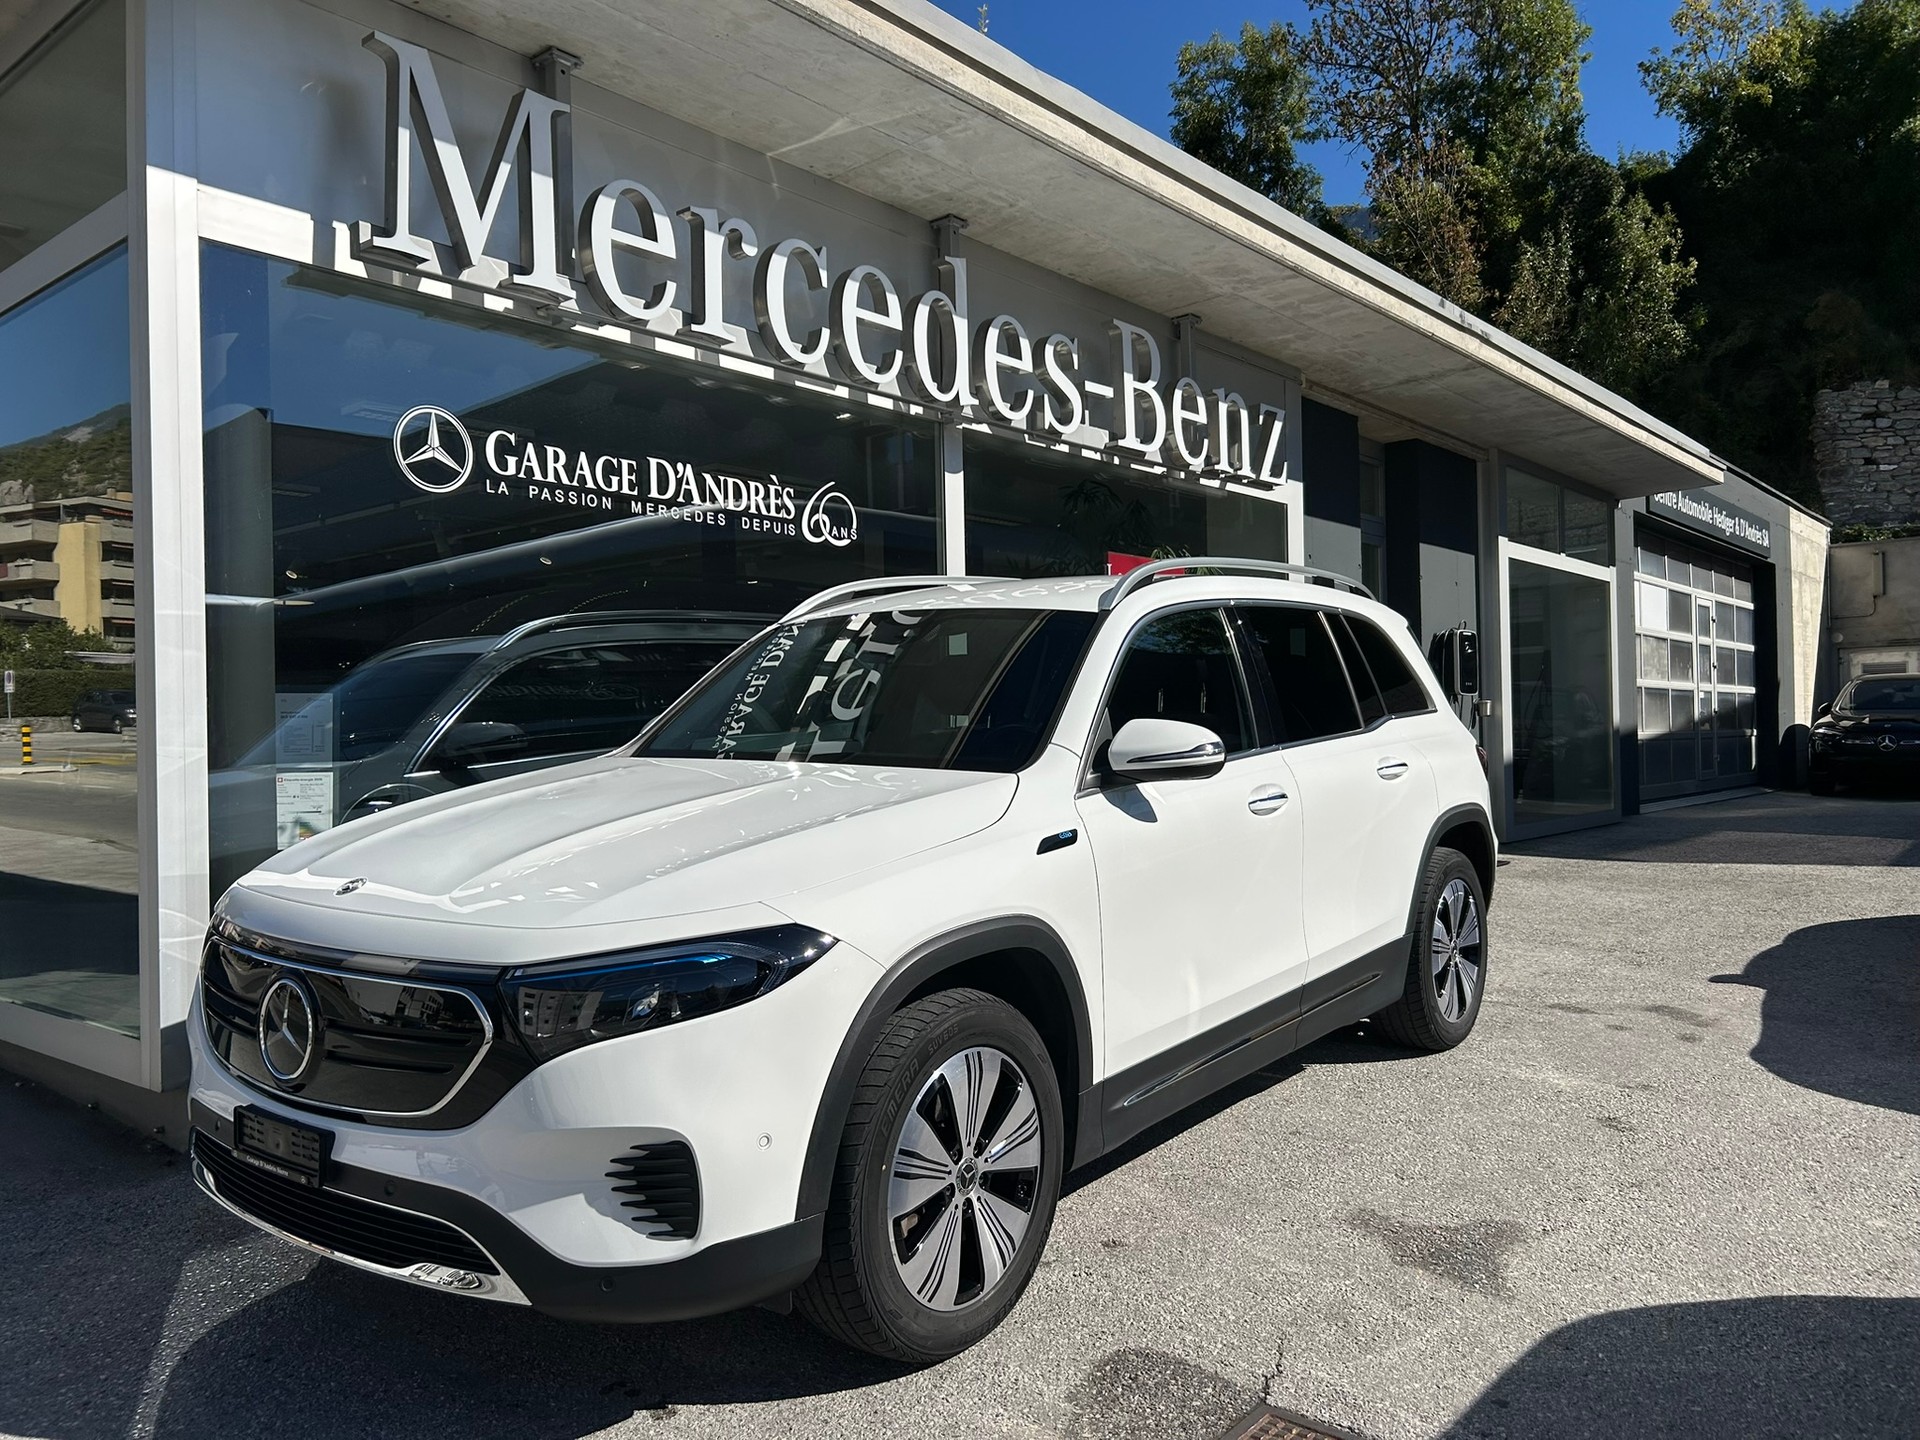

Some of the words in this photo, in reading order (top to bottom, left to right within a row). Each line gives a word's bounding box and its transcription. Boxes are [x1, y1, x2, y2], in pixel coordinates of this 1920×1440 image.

[361, 30, 1288, 487] Mercedes-Benz
[485, 430, 638, 496] GARAGE
[646, 456, 796, 520] D'ANDRÈS
[486, 478, 510, 496] LA
[528, 485, 613, 511] PASSION
[631, 500, 727, 527] MERCEDES
[741, 516, 797, 537] DEPUIS
[831, 526, 858, 541] ANS
[1677, 490, 1713, 525] Automobile
[1735, 516, 1740, 536] &
[1762, 528, 1770, 548] SA
[881, 1057, 919, 1137] EMERA
